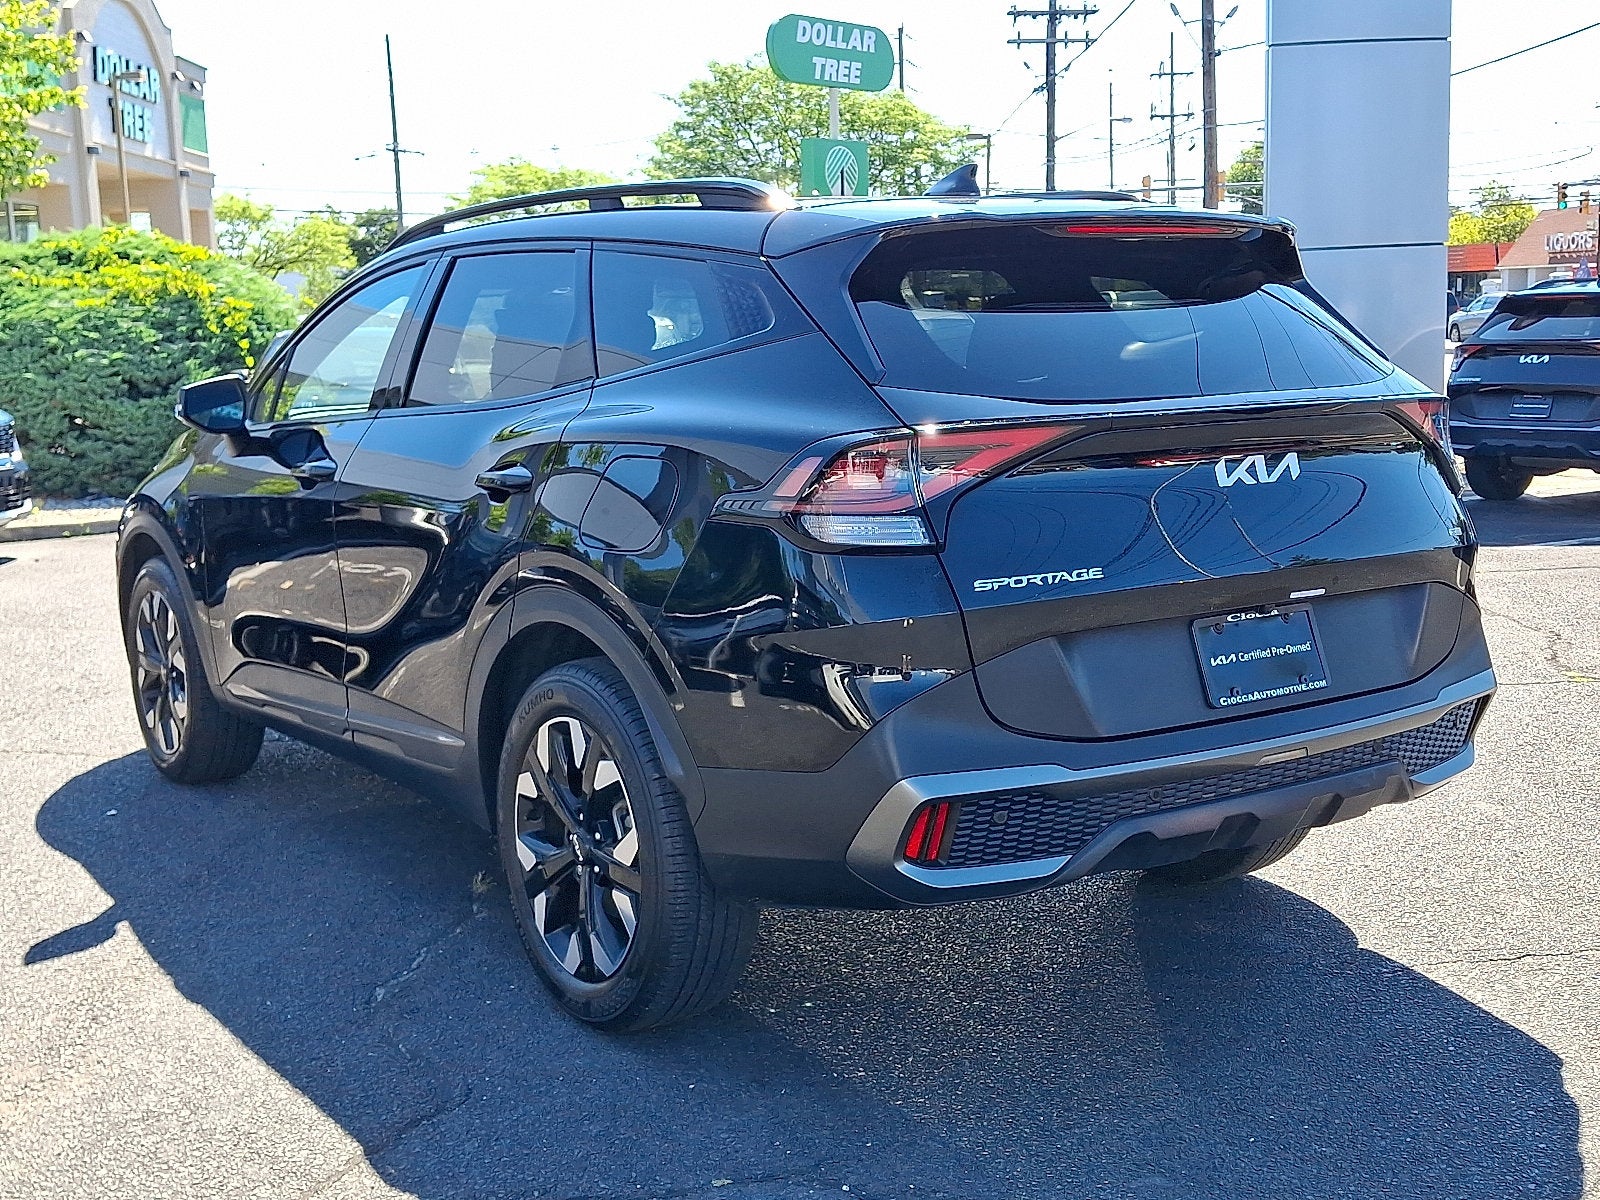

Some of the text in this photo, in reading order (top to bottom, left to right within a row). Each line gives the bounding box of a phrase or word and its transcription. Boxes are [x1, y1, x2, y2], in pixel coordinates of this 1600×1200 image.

[796, 20, 876, 53] DOLLAR
[812, 56, 862, 84] TREE
[1544, 233, 1594, 251] LIQUORS
[1214, 452, 1301, 487] KIA
[973, 567, 1105, 592] SPORTAGE
[1210, 642, 1311, 667] KIA Certified Pre-Owned
[518, 688, 554, 724] KUMHO
